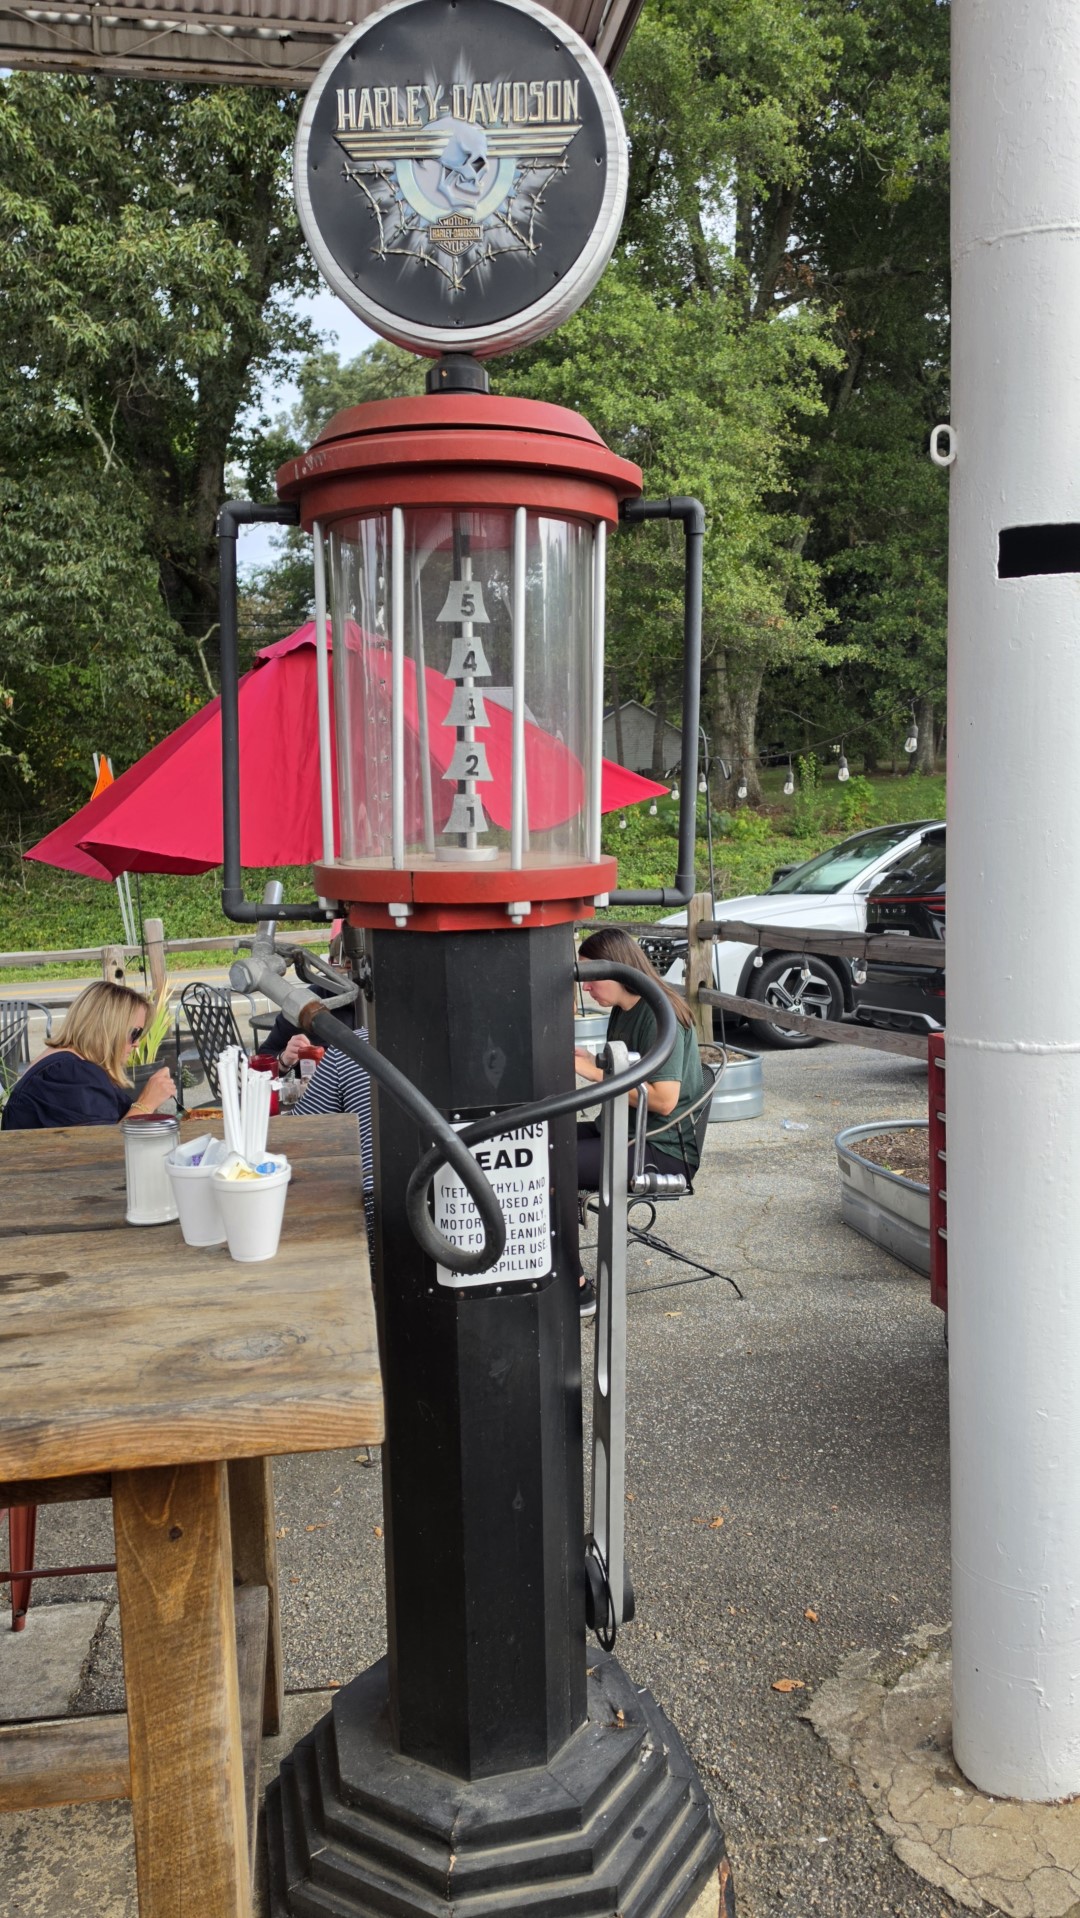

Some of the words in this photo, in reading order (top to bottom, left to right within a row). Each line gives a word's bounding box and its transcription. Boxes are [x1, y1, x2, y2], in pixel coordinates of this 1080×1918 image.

[336, 79, 582, 131] HARLEY-DAVIDSON
[460, 593, 475, 617] 5
[462, 650, 477, 672] 4
[465, 754, 479, 777] 2
[466, 806, 475, 828] 1
[475, 1148, 533, 1171] EAD
[528, 1176, 546, 1191] AND
[445, 1203, 456, 1215] IS
[460, 1202, 476, 1215] TO
[533, 1193, 543, 1206] AS
[440, 1218, 482, 1231] MOTOR
[443, 1235, 464, 1246] OT
[469, 1233, 483, 1245] FO
[491, 1257, 543, 1273] SPILLING
